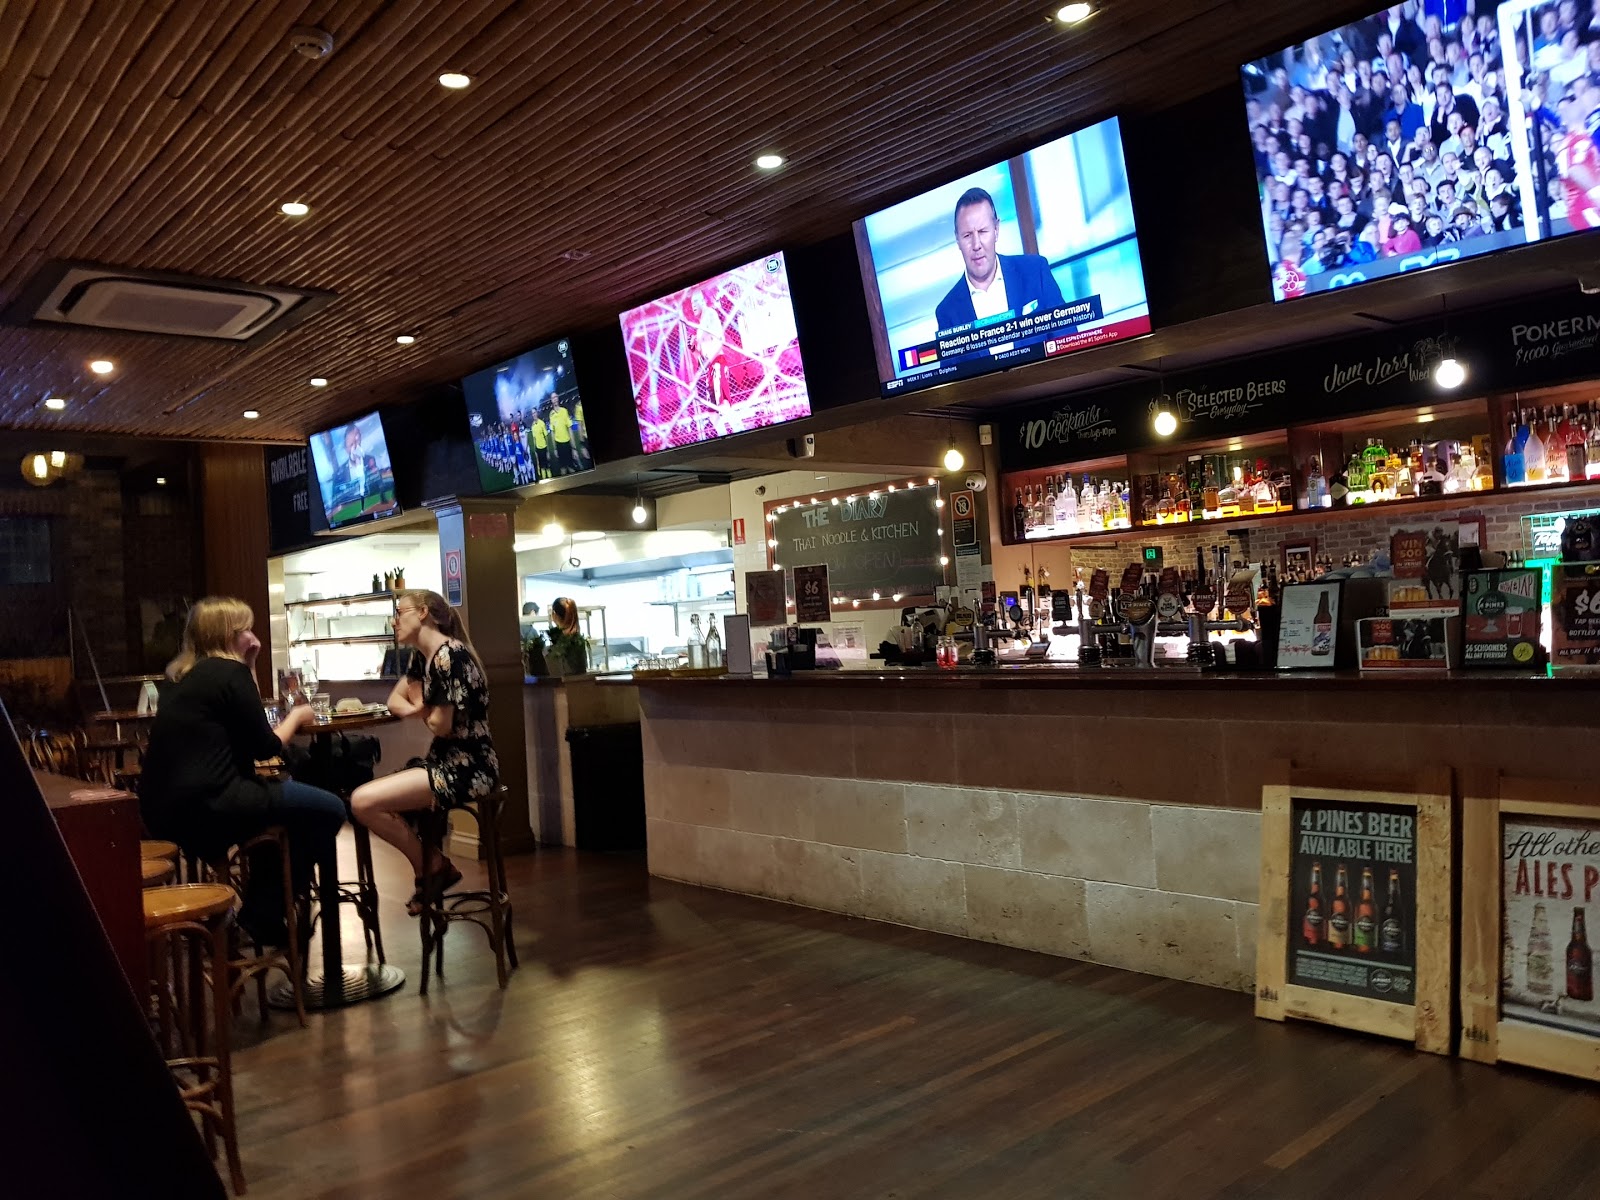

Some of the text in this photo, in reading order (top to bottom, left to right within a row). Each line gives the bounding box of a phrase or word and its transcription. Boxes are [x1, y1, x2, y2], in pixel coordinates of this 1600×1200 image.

[938, 328, 953, 337] CRAIG
[953, 323, 972, 333] BURLEY
[940, 302, 1091, 350] Reaction to France 2-1 win over Germany
[941, 345, 965, 358] Germany:
[966, 343, 970, 351] 6
[970, 340, 987, 350] losses
[987, 337, 997, 346] this
[998, 329, 1020, 343] calendar
[1021, 327, 1034, 338] year
[1034, 322, 1051, 334] (most
[1058, 317, 1073, 327] team
[1073, 310, 1096, 323] history)
[1060, 341, 1080, 350] Download
[1094, 333, 1109, 342] Sports
[1108, 331, 1118, 339] App
[887, 379, 904, 390] ESPN
[938, 365, 958, 375] Dolphins
[1323, 352, 1410, 393] Jam Jars
[1188, 379, 1287, 412] SELECTED BEERS
[1209, 402, 1249, 420] Everyday
[1019, 404, 1101, 450] $10 Cocktails
[270, 447, 307, 486] AVAILABLE
[801, 496, 888, 529] THE DIARY
[792, 520, 920, 552] THAI NOODLE & KITCHEN
[804, 580, 819, 596] $6
[1568, 628, 1595, 637] BOTTLED
[1465, 643, 1474, 653] $6
[1474, 643, 1508, 652] SCHOONERS
[1483, 651, 1508, 659] EVERYDAY
[1300, 809, 1413, 838] 4 PINES BEER
[1300, 835, 1413, 864] AVAILABLE HERE
[1504, 831, 1556, 860] All
[1515, 858, 1600, 903] ALES P
